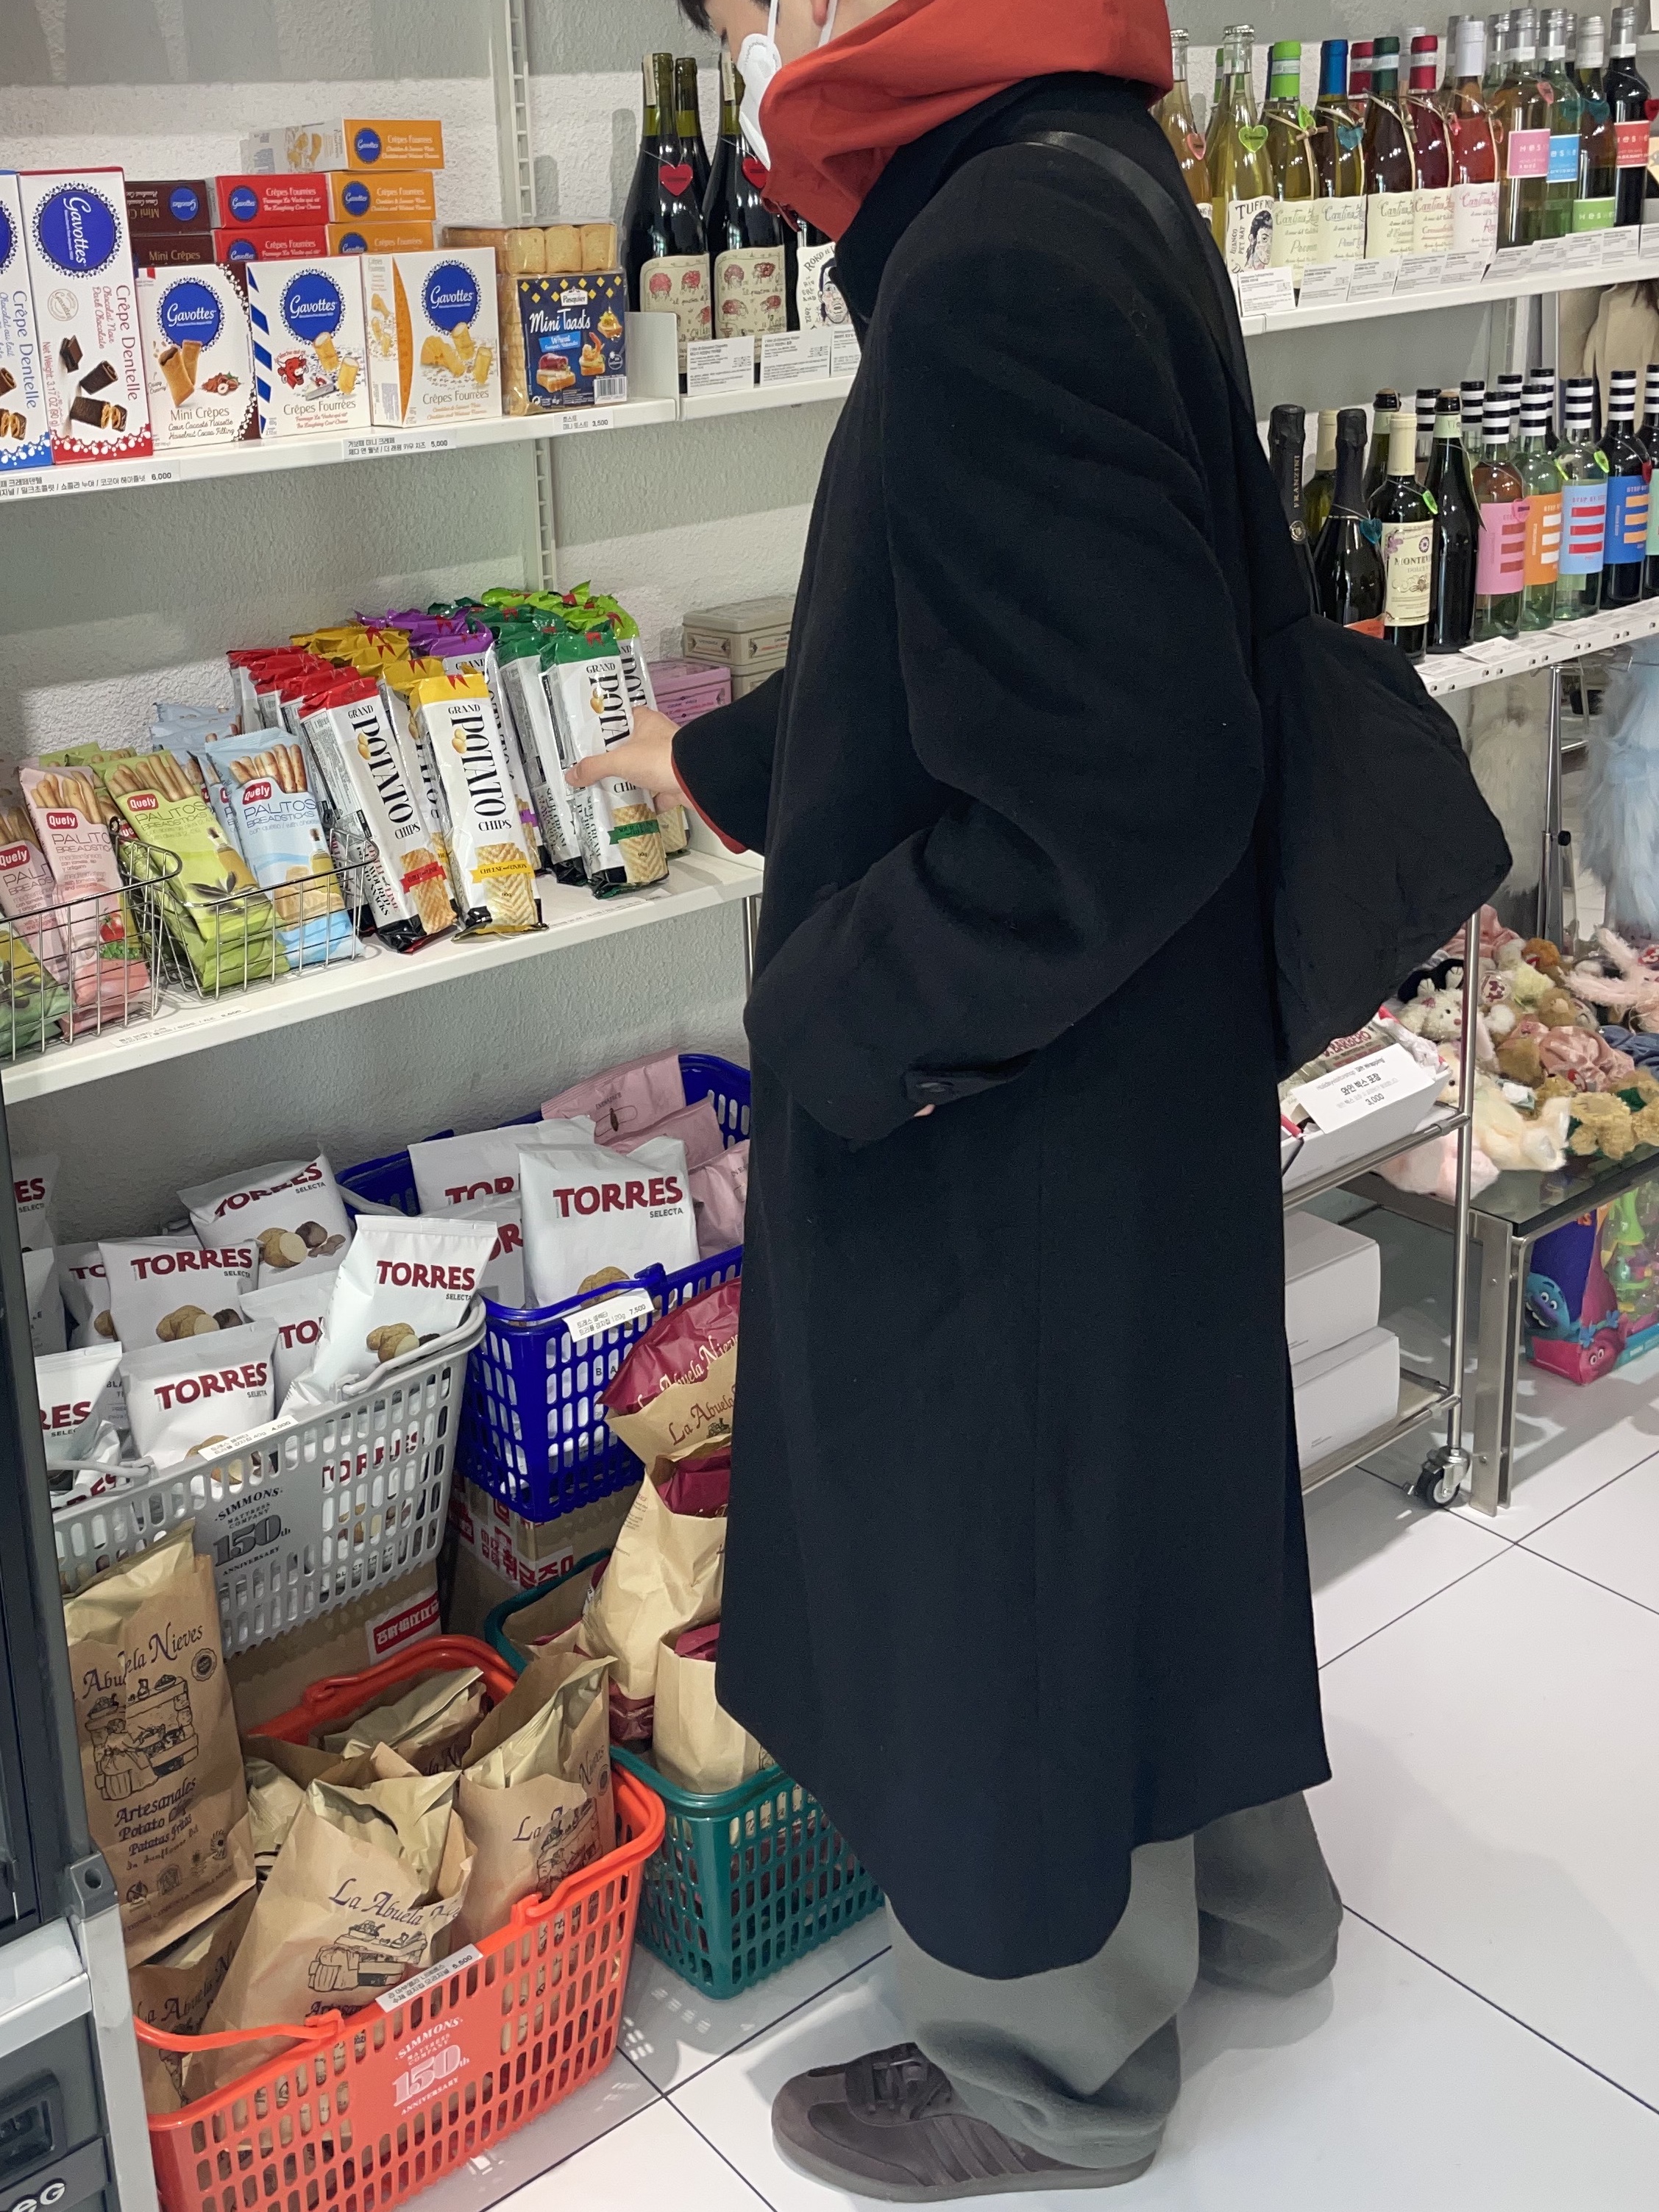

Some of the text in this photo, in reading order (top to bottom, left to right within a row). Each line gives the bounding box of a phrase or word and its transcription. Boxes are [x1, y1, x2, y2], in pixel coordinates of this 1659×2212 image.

[63, 196, 91, 265] Gavottes
[149, 248, 200, 261] Mini Crêpes
[290, 294, 338, 319] Gavottes
[430, 285, 473, 309] Gavottes
[167, 302, 216, 327] Gavottes
[529, 308, 591, 334] Mini Toasts
[13, 291, 40, 409] Crêpe Dentelle
[116, 285, 141, 401] Crêpe Dentelle
[422, 389, 490, 405] Crêpes Fourrées
[171, 406, 230, 421] Mini Crêpes
[284, 400, 356, 416] Crêpes Fourrées
[430, 439, 448, 447] 5,000
[151, 472, 172, 481] 6,000
[586, 662, 616, 673] GRAND
[348, 704, 374, 720] GRAND
[448, 703, 480, 715] GRAND
[589, 673, 634, 748] POTA
[351, 715, 413, 824] POTATO
[450, 714, 507, 817] POTATO
[244, 784, 271, 801] Quely
[614, 782, 637, 794] CHI
[130, 797, 156, 809] Quely
[135, 801, 208, 825] PALITOS
[244, 799, 317, 820] PALITOS
[49, 815, 76, 826] Quely
[142, 812, 207, 831] BREADSTICKS
[247, 811, 315, 829] BREADSTICKS
[394, 821, 422, 840] CHIPS
[478, 819, 512, 832] CHIPS
[51, 832, 111, 845] PALITO
[0, 849, 27, 867] Quely
[55, 845, 111, 854] BREADSTIC
[1340, 1072, 1382, 1096] 와인 박스 포장
[1365, 1093, 1385, 1106] 3,000
[295, 1181, 327, 1194] SELECTA
[553, 1176, 683, 1219] TORRES
[650, 1207, 683, 1219] SELECTA
[131, 1248, 252, 1280] TORRES
[224, 1270, 251, 1278] SELECTA
[377, 1260, 475, 1291] TORRES
[446, 1293, 472, 1301] SELECTA
[611, 1313, 626, 1323] 120g
[629, 1303, 646, 1316] 7,500
[154, 1362, 268, 1411] TORRES
[246, 1389, 268, 1399] SELECTA
[51, 1428, 77, 1439] SELEC
[668, 1421, 694, 1446] La
[218, 1487, 280, 1522] SIMMONS
[227, 1501, 271, 1525] MATTRESS
[229, 1508, 269, 1529] COMPANY
[223, 1545, 280, 1576] ANNIVERSARY
[149, 1622, 204, 1663] Nieves
[114, 1776, 196, 1828] Artesanales
[118, 1818, 166, 1843] Potato
[512, 1815, 542, 1843] La
[328, 1878, 424, 1926] La Abuela
[398, 2016, 461, 2058] SIMMONS
[401, 2077, 460, 2116] ANNIVERSARY
